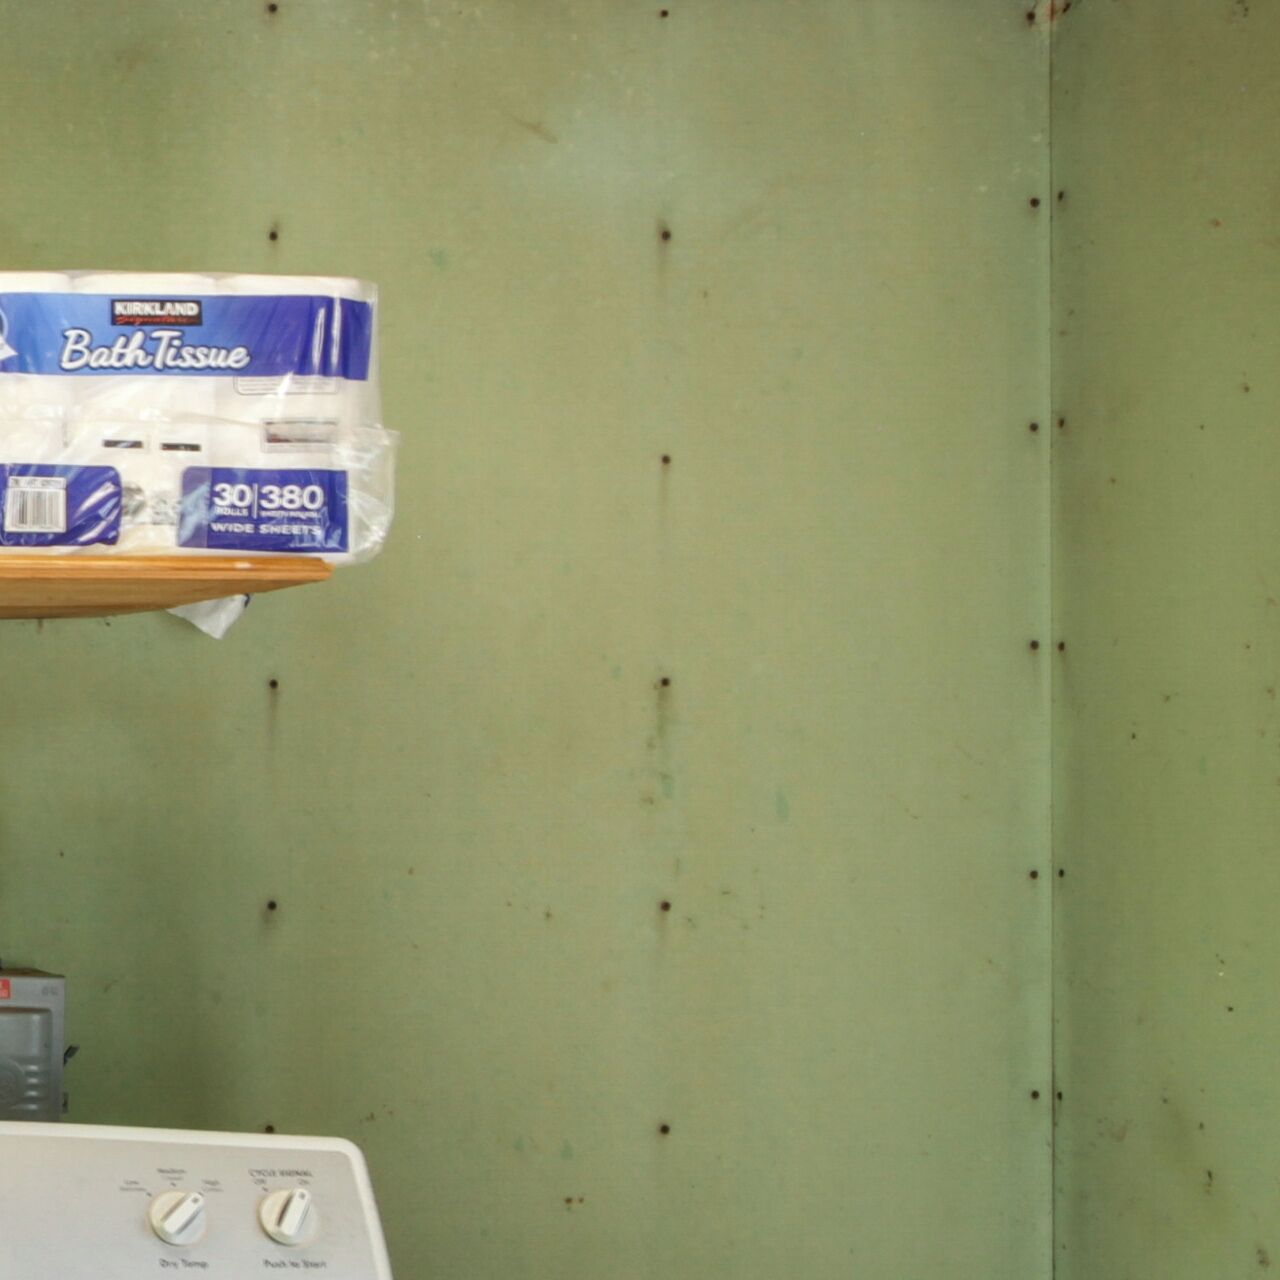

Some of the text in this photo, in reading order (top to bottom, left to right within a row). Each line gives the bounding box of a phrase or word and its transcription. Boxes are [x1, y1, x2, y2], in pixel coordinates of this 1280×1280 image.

[114, 301, 200, 316] KIRKLAND
[59, 328, 251, 371] Bath Tissue
[213, 483, 324, 511] 30 380
[210, 522, 322, 536] WIDE SHEETS
